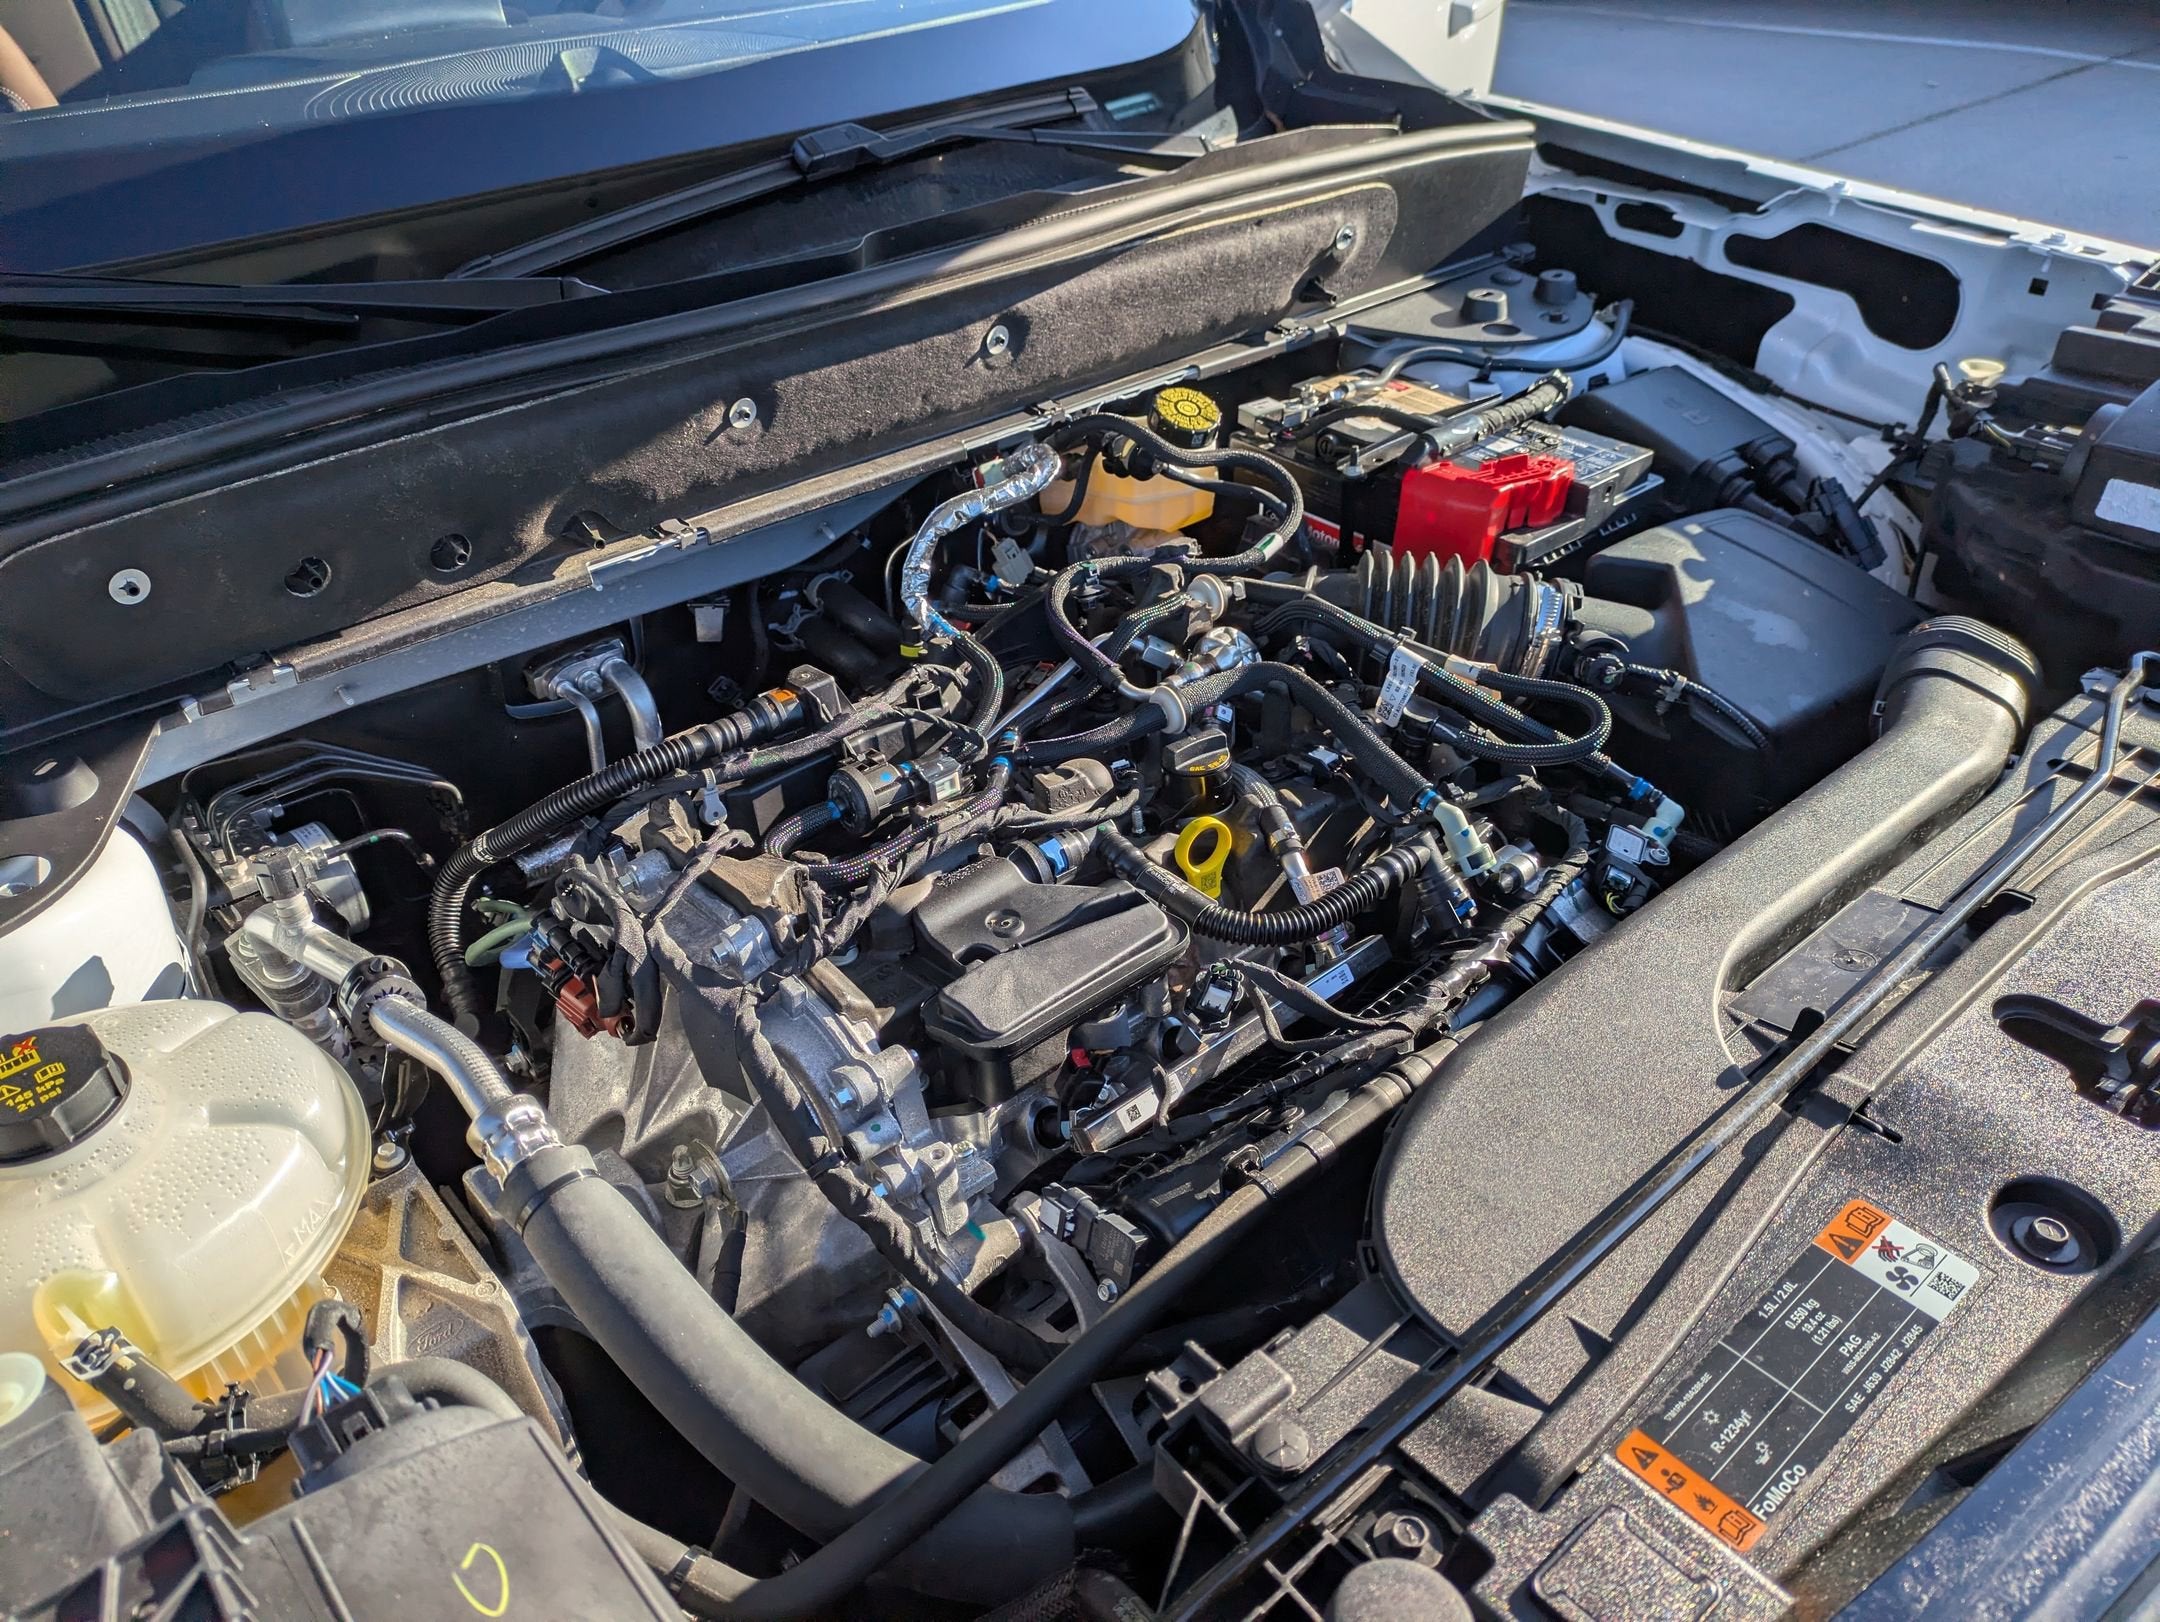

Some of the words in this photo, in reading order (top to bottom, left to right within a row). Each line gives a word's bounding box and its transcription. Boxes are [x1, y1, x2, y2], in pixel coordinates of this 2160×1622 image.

[6, 1090, 33, 1107] 145
[35, 1077, 65, 1094] kPa
[17, 1099, 36, 1113] 21
[39, 1087, 62, 1104] psi
[1758, 1302, 1780, 1319] 1.5L
[1777, 1282, 1798, 1299] 2.0L
[1785, 1307, 1809, 1329] 0.550
[1801, 1299, 1820, 1310] kg
[1815, 1311, 1826, 1321] oz
[1824, 1314, 1843, 1330] lbs)
[416, 1321, 453, 1353] Ford
[1839, 1334, 1862, 1357] PAG
[1845, 1392, 1866, 1413] SAE
[1862, 1372, 1882, 1394] J639
[1880, 1348, 1904, 1373] J2842
[1901, 1324, 1924, 1348] J2845
[1710, 1409, 1753, 1454] R-1234yf
[1751, 1464, 1807, 1521] FoMoCo
